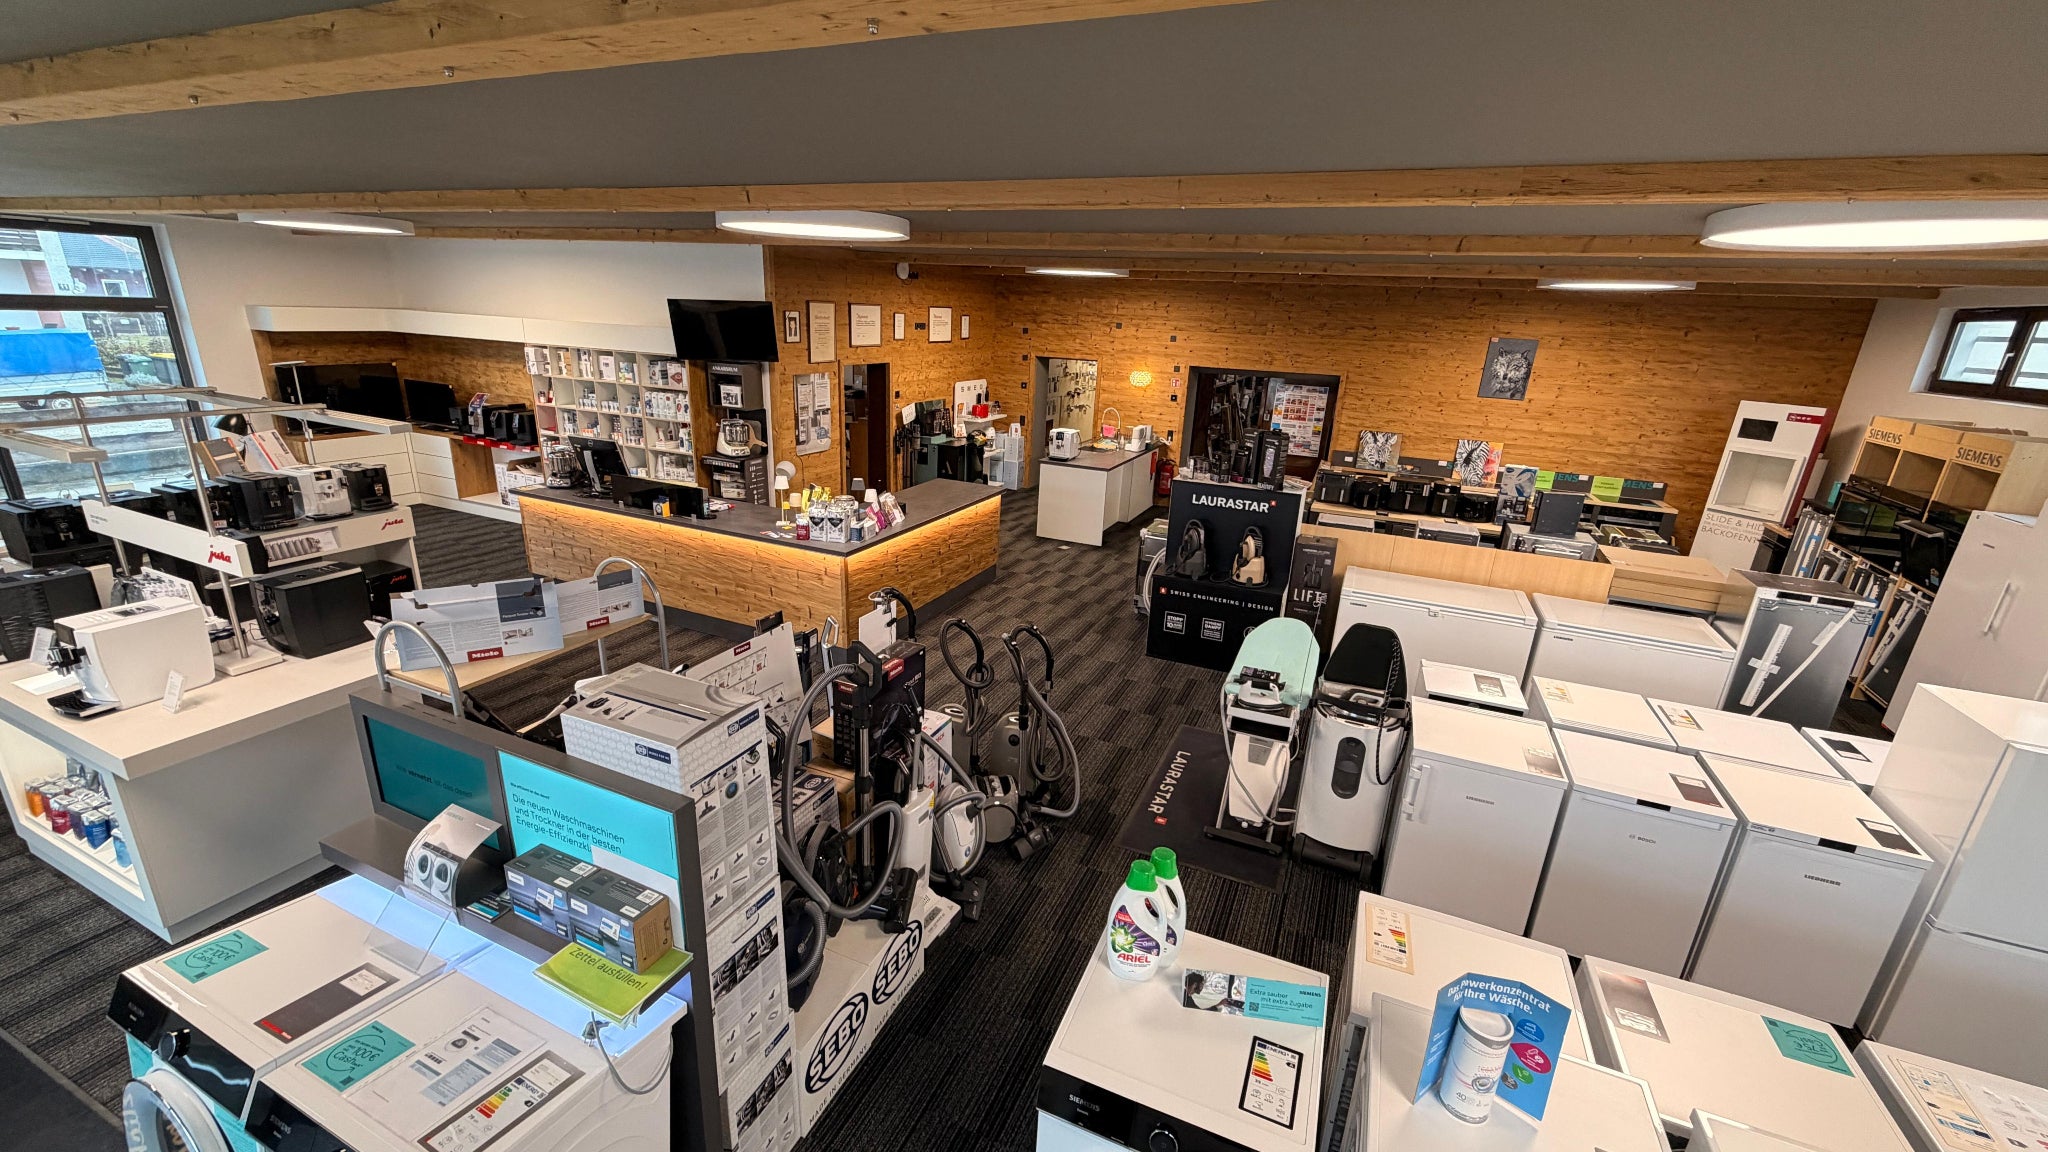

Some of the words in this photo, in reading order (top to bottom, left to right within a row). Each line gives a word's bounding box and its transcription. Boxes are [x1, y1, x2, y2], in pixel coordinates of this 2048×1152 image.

[1868, 428, 1903, 445] SIEMENS
[1955, 447, 2003, 468] SIEMENS
[1192, 494, 1269, 513] LAURASTAR
[381, 518, 404, 530] jura
[1706, 513, 1732, 524] SLIDE
[208, 545, 232, 563] jura
[1193, 594, 1240, 606] ENGINEERING
[1248, 602, 1274, 612] DESIGN
[1294, 588, 1322, 602] LIFT
[472, 650, 500, 659] Miele
[1148, 751, 1191, 814] LAURASTAR
[512, 794, 526, 806] Die
[527, 800, 552, 816] neuen
[552, 808, 625, 844] Waschmaschinen
[514, 806, 530, 817] und
[530, 811, 564, 830] Trockner
[566, 824, 574, 834] in
[576, 830, 590, 841] der
[592, 835, 622, 854] besten
[875, 926, 920, 1000] SEBO
[1117, 952, 1151, 964] ARIEL
[568, 948, 602, 966] Zettel
[597, 963, 648, 990] ausfüllen!
[1250, 988, 1266, 996] Extra
[1267, 991, 1288, 999] sauber
[1299, 990, 1322, 998] SIEMENS
[1448, 984, 1460, 998] Das
[1460, 980, 1551, 1013] Powerkonzentrat
[1464, 988, 1486, 1000] Ihre
[1489, 992, 1533, 1015] Wäsche.
[1272, 998, 1288, 1006] extra
[1289, 1000, 1313, 1009] Zugabe
[874, 1008, 889, 1034] MADE
[890, 1000, 896, 1012] IN
[809, 998, 866, 1090] SEBO
[352, 1046, 380, 1062] 100€
[809, 1096, 828, 1126] MADE
[829, 1084, 838, 1099] IN
[838, 1043, 868, 1085] GERMANY
